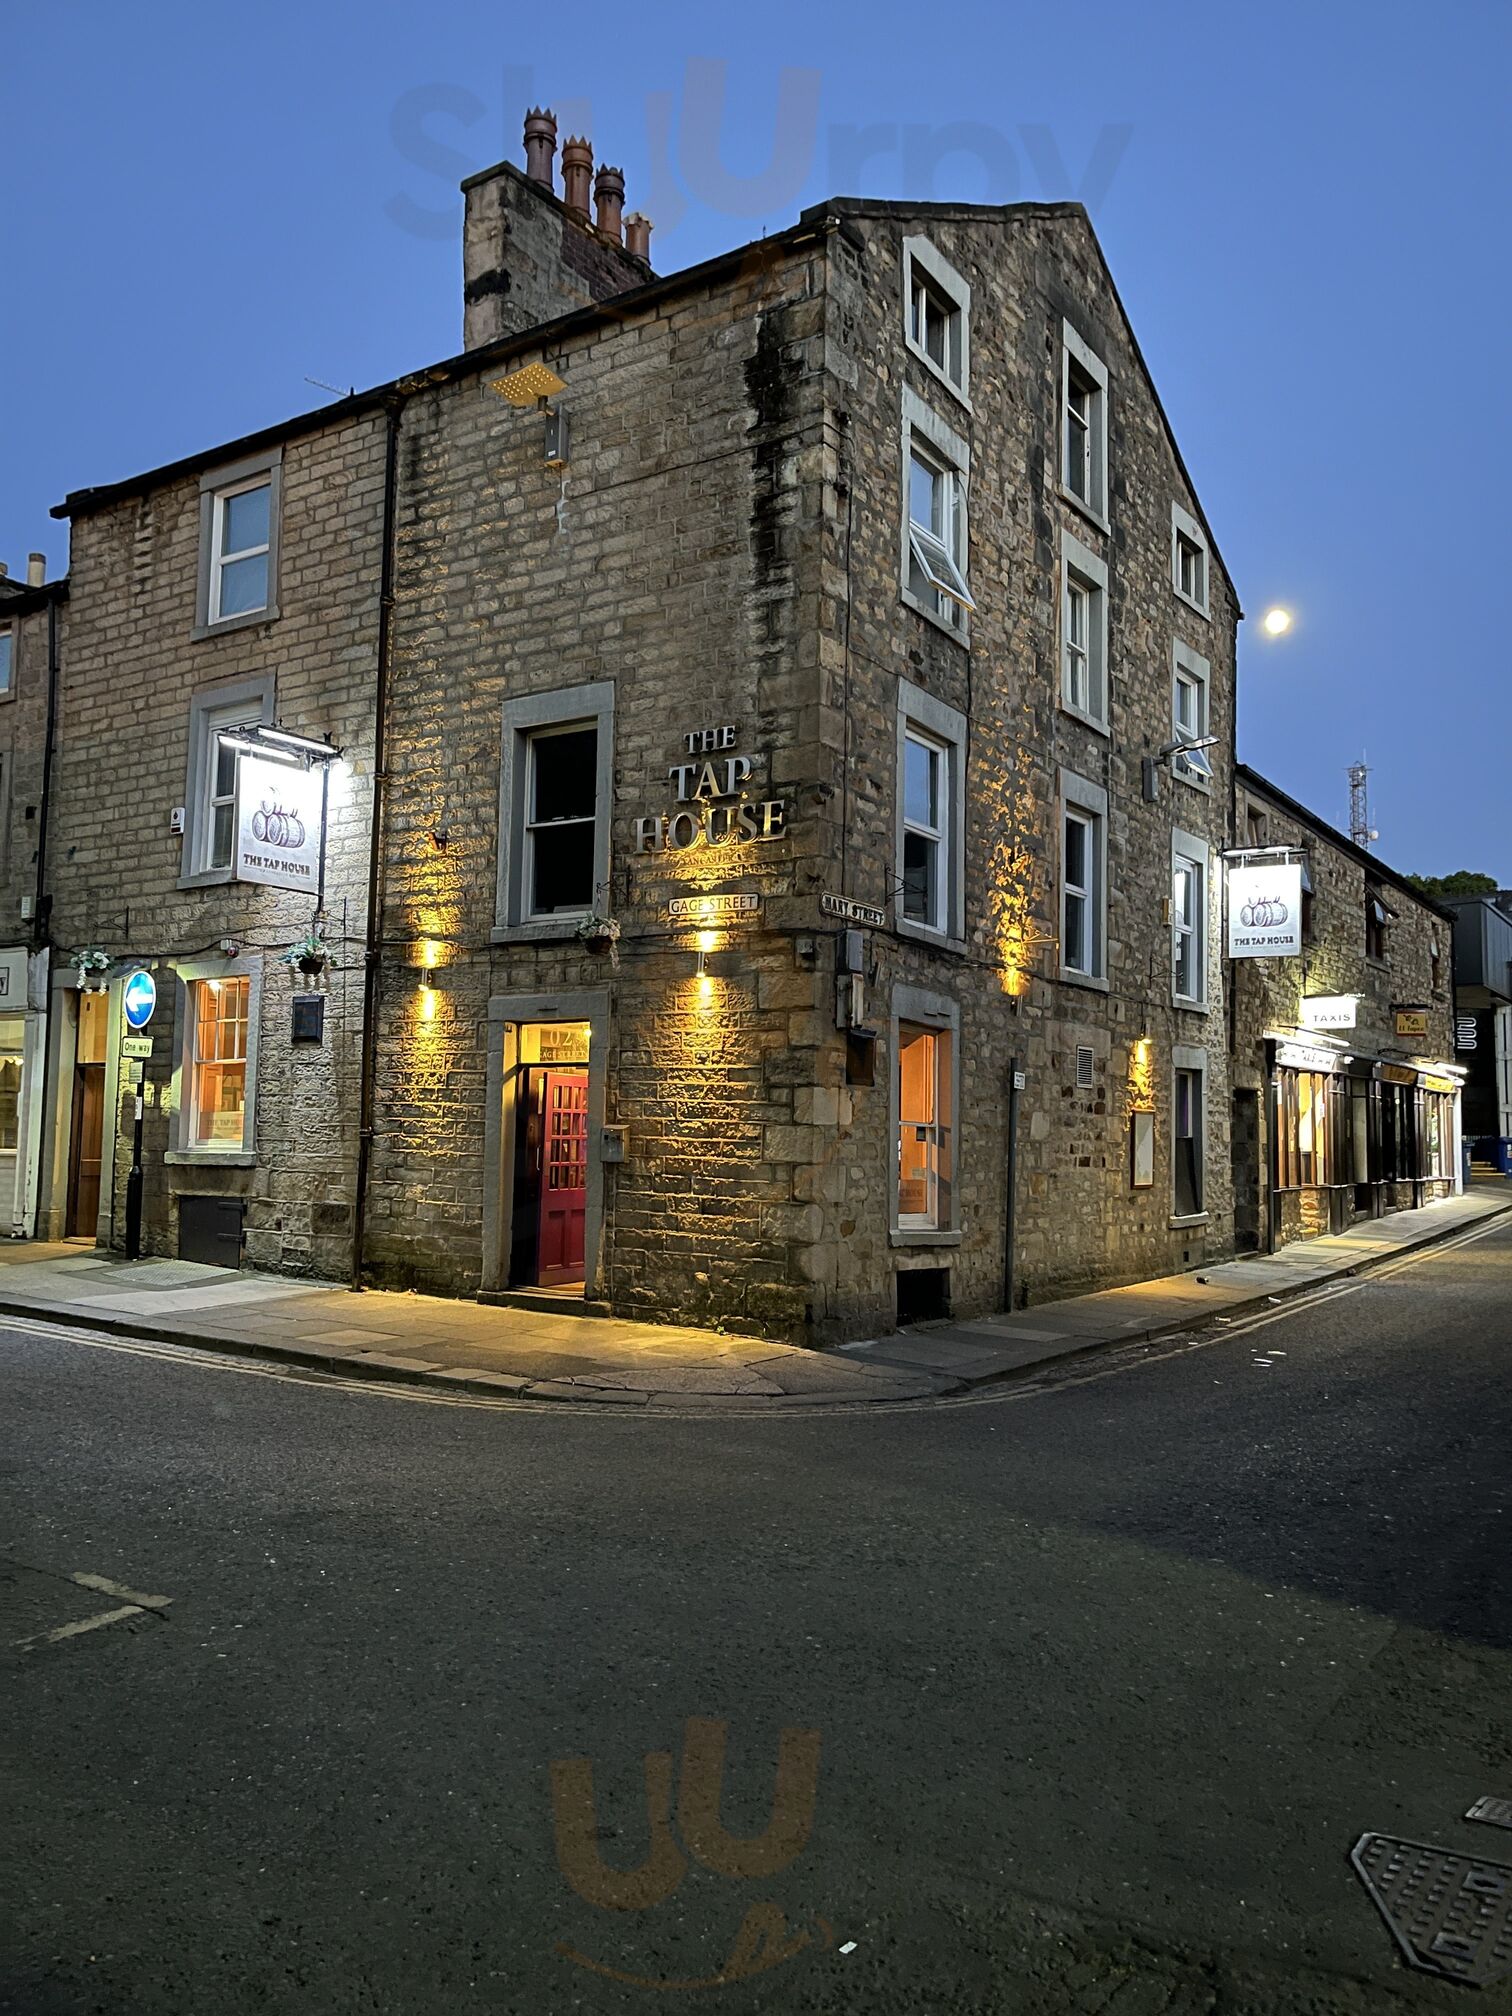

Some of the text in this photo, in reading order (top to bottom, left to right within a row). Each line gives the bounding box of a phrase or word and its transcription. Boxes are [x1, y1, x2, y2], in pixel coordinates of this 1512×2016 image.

[684, 726, 736, 754] THE
[669, 757, 751, 801] TAP
[633, 800, 785, 854] HOUSE
[244, 854, 262, 866] THE
[264, 858, 280, 869] TAP
[281, 861, 310, 875] HOUSE
[672, 896, 755, 913] GAGE STREET
[824, 896, 883, 924] MARY STREET
[1234, 936, 1294, 946] THE TAP HOUSE
[1313, 1014, 1351, 1022] TAXIS
[124, 1042, 150, 1053] One way
